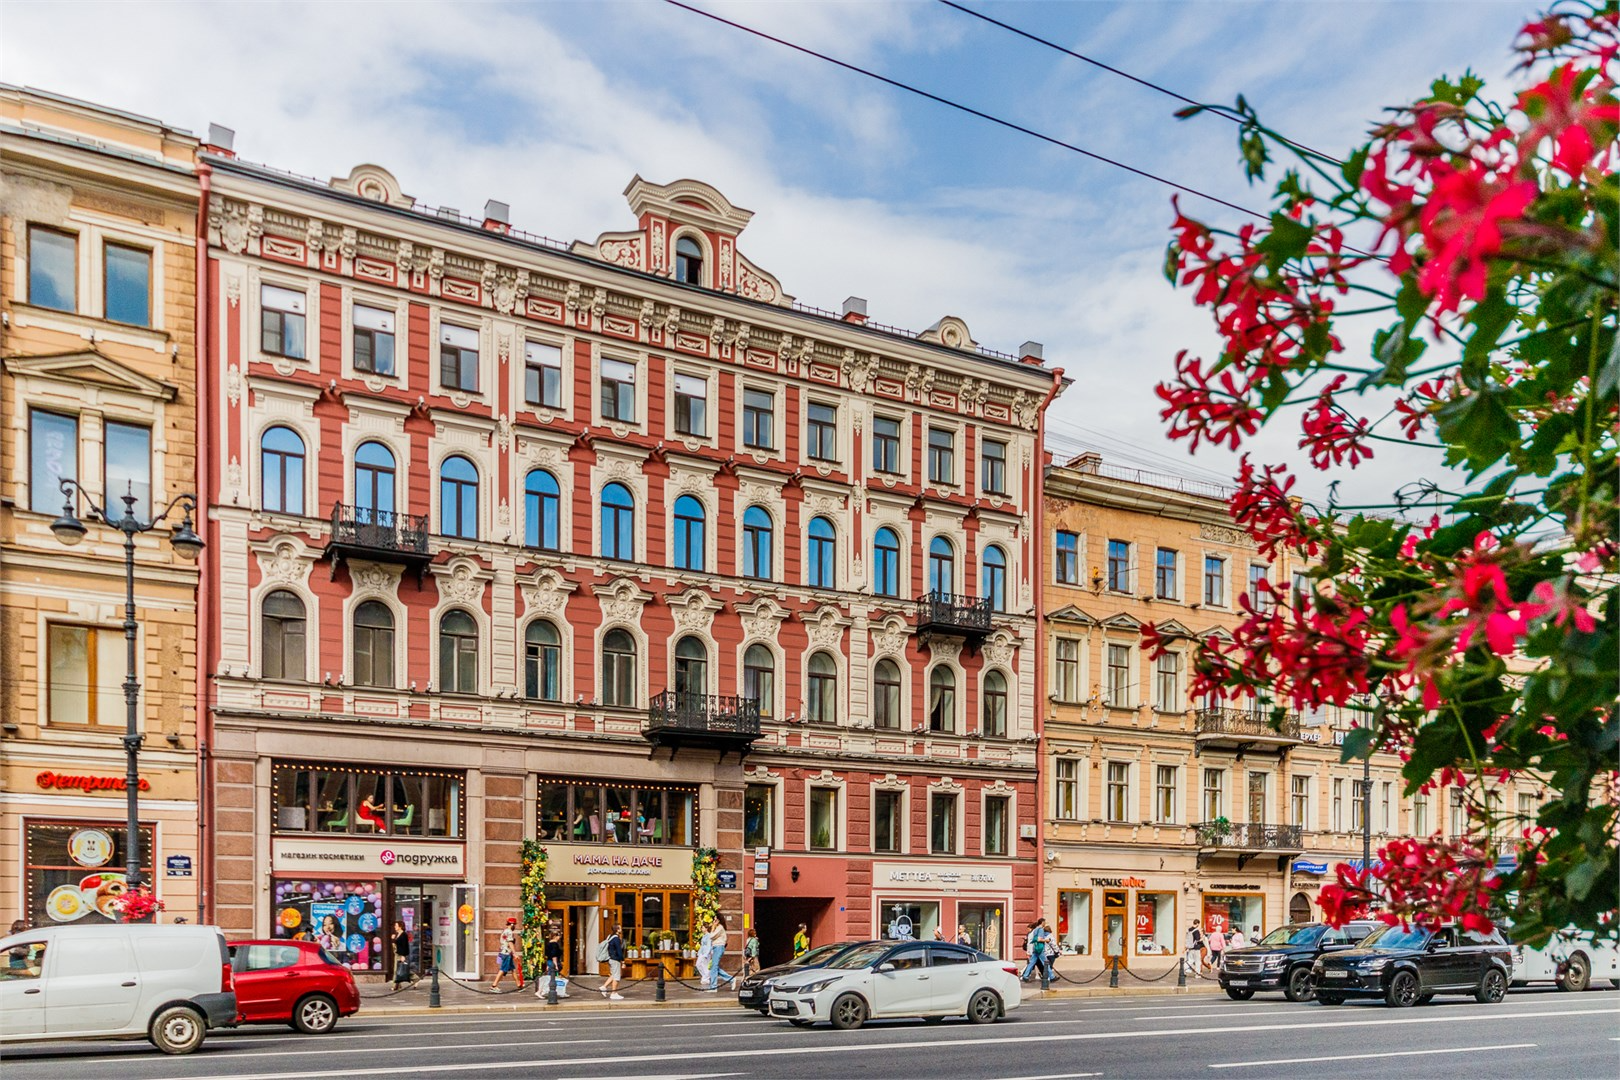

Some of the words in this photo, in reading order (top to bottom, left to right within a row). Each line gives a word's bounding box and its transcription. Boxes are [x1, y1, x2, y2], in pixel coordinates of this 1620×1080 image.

[396, 853, 458, 866] подружка
[573, 854, 610, 866] МАМА
[612, 855, 629, 867] НА
[631, 856, 662, 868] ДАЧЕ
